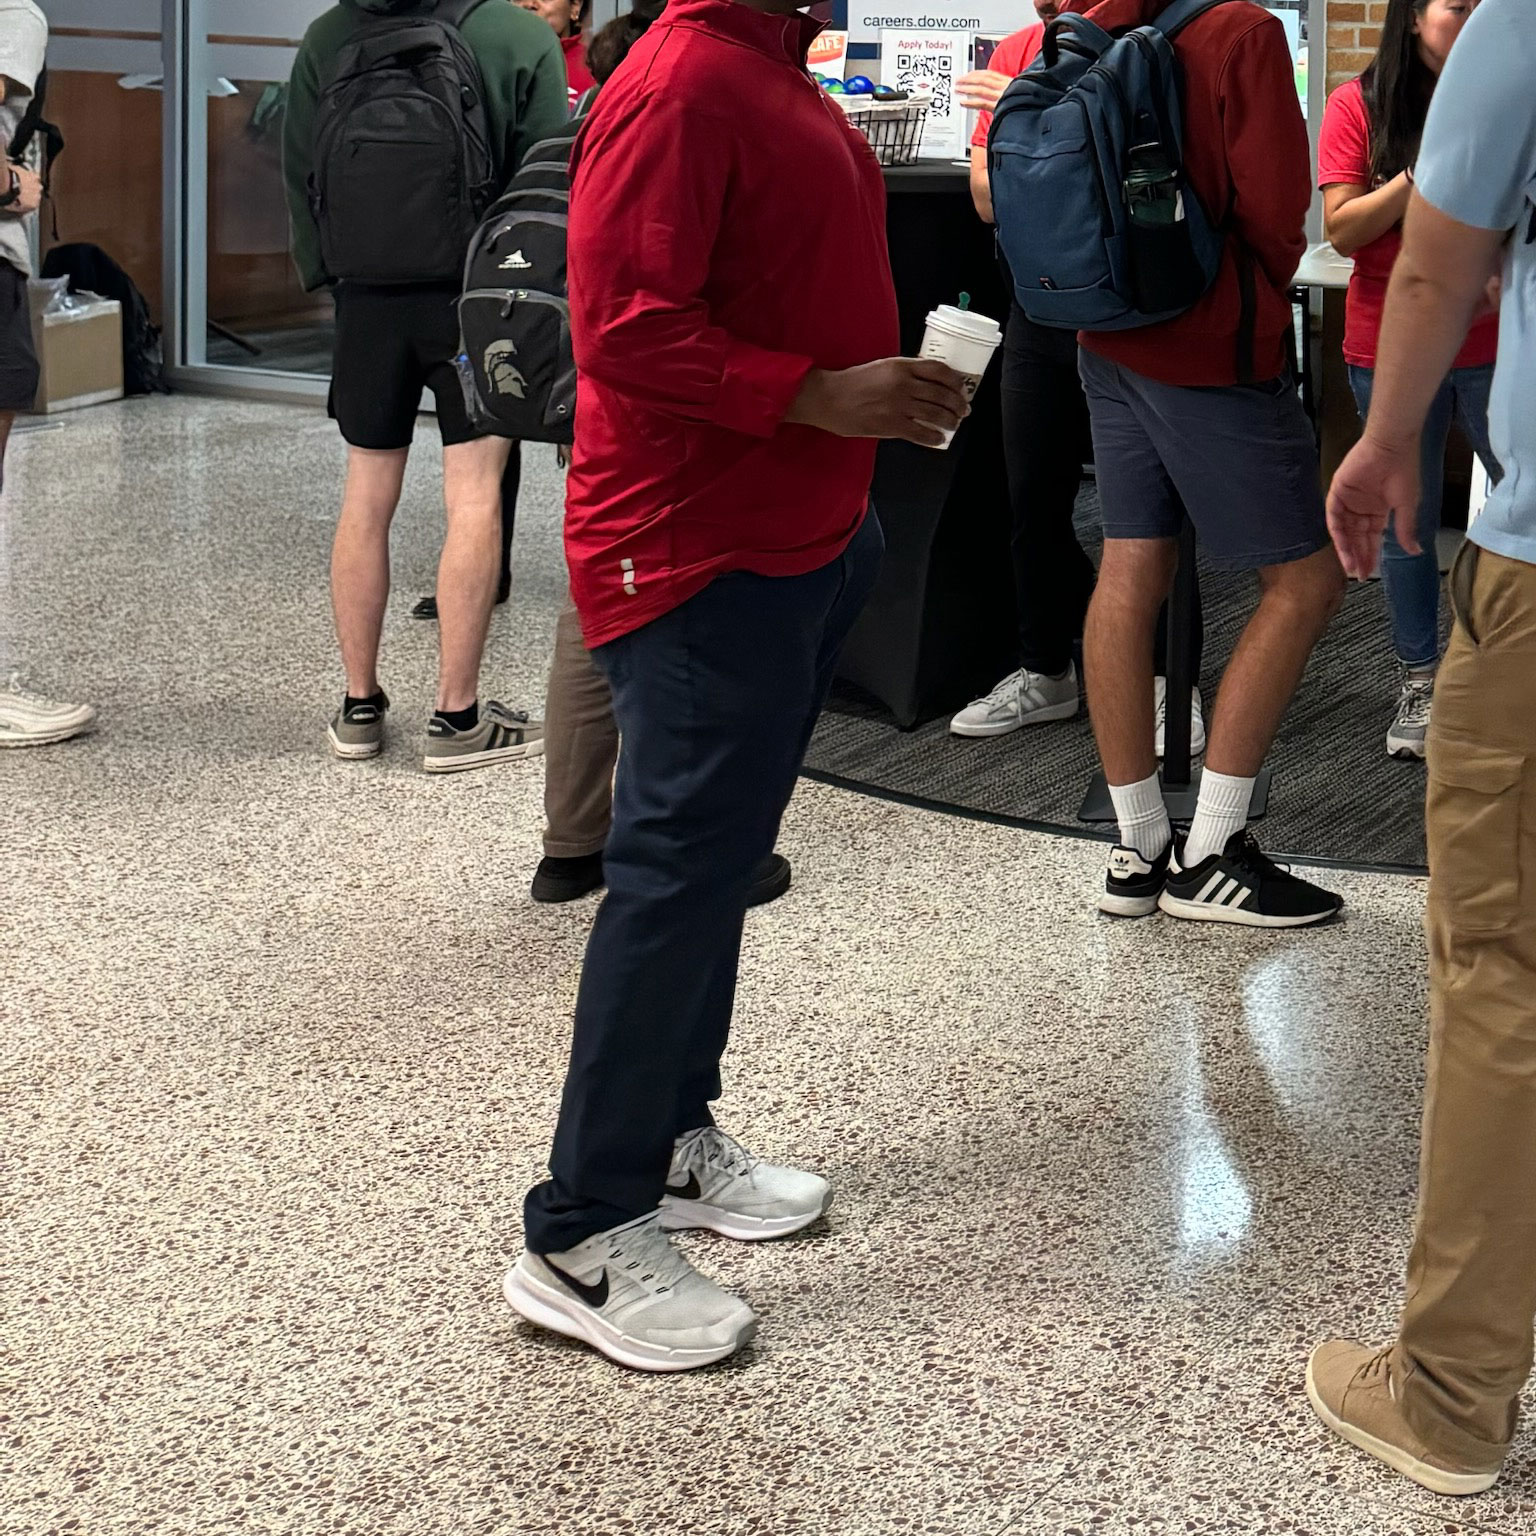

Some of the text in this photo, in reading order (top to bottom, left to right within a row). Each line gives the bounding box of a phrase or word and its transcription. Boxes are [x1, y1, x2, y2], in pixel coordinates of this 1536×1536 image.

[863, 16, 980, 29] careers.dow.com
[898, 40, 952, 50] Apply Today!
